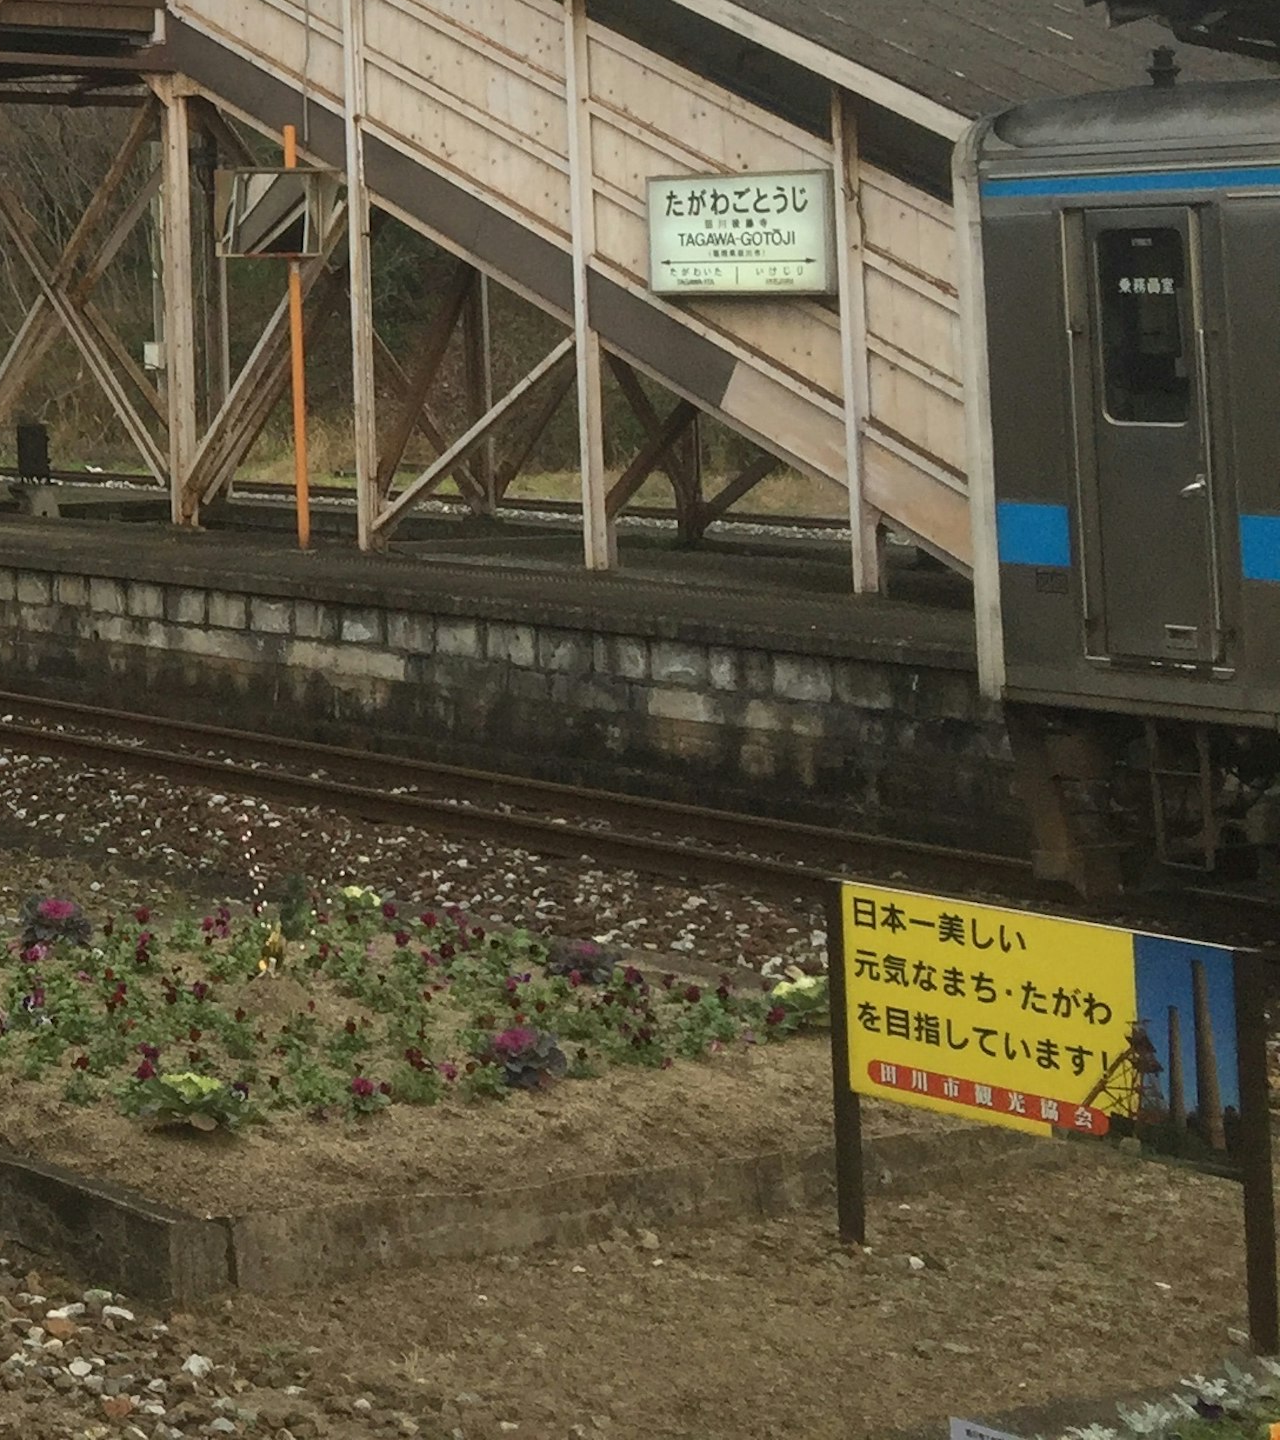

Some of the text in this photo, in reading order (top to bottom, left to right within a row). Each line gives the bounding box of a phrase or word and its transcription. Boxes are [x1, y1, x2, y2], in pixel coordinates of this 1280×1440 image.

[666, 186, 808, 216] たがわごとうじ
[670, 267, 723, 277] たがわいた
[853, 897, 1026, 954] 日本一美しい
[854, 948, 1113, 1026] 元気なまち・たがわ
[879, 1062, 1094, 1130] 田川市観光協会
